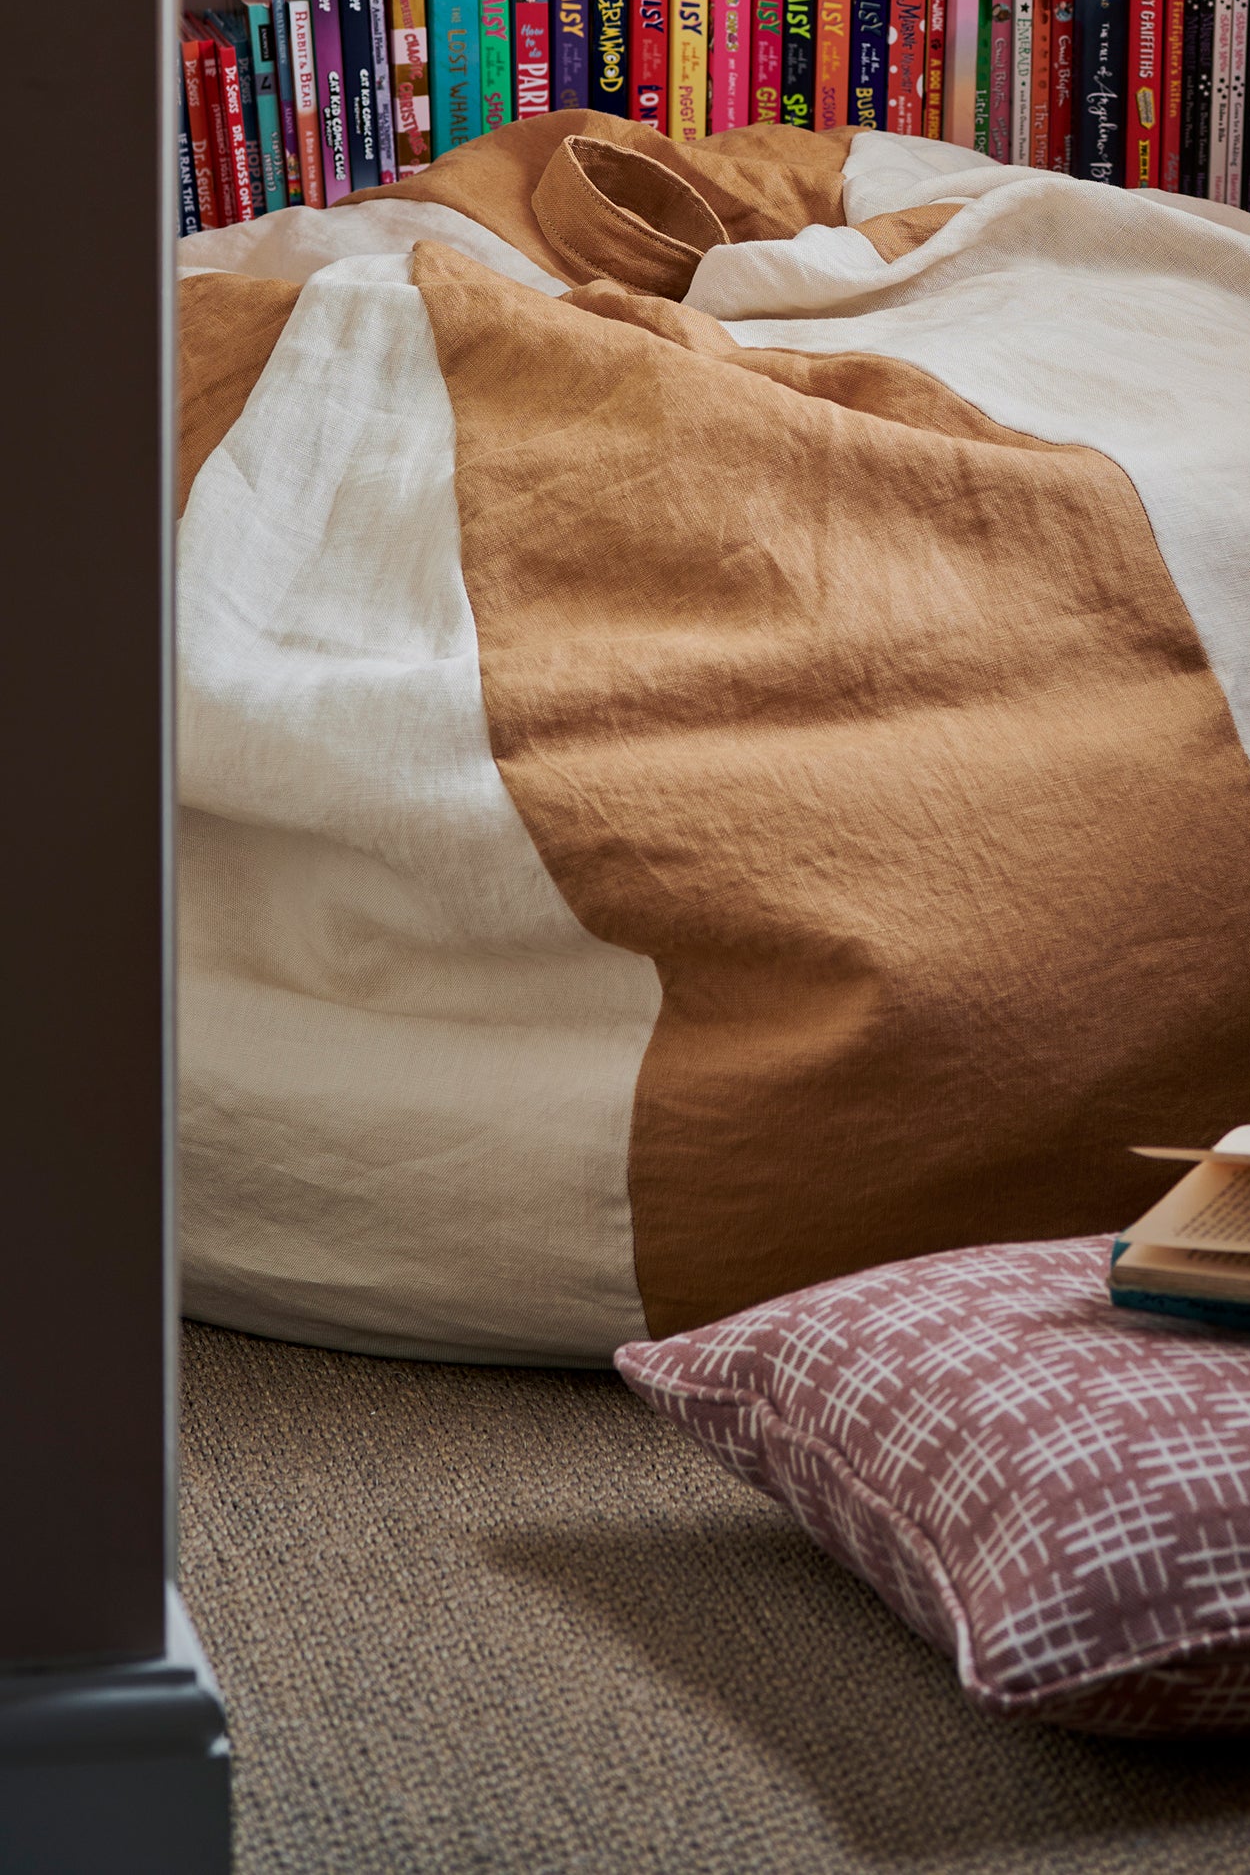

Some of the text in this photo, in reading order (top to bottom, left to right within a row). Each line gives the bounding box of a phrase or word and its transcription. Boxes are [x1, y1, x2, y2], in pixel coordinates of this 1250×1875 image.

[521, 23, 544, 37] How
[525, 37, 537, 48] to
[1017, 18, 1032, 81] EMERALD
[1138, 9, 1155, 79] GRIFFITHS
[294, 11, 313, 109] RABBIT BEAR
[447, 6, 469, 145] THE LOST WHALE
[186, 78, 200, 107] Seuss
[224, 66, 239, 115] Dr. Seuss
[396, 33, 428, 157] CHAOTIC CHRISTMAS
[975, 89, 987, 126] Little
[1169, 79, 1182, 118] Kitten
[1034, 104, 1049, 130] The
[178, 133, 195, 213] IF RAN THE
[192, 139, 207, 164] Dr.
[232, 125, 251, 206] DR. SEUSS ON
[246, 140, 260, 177] HOP
